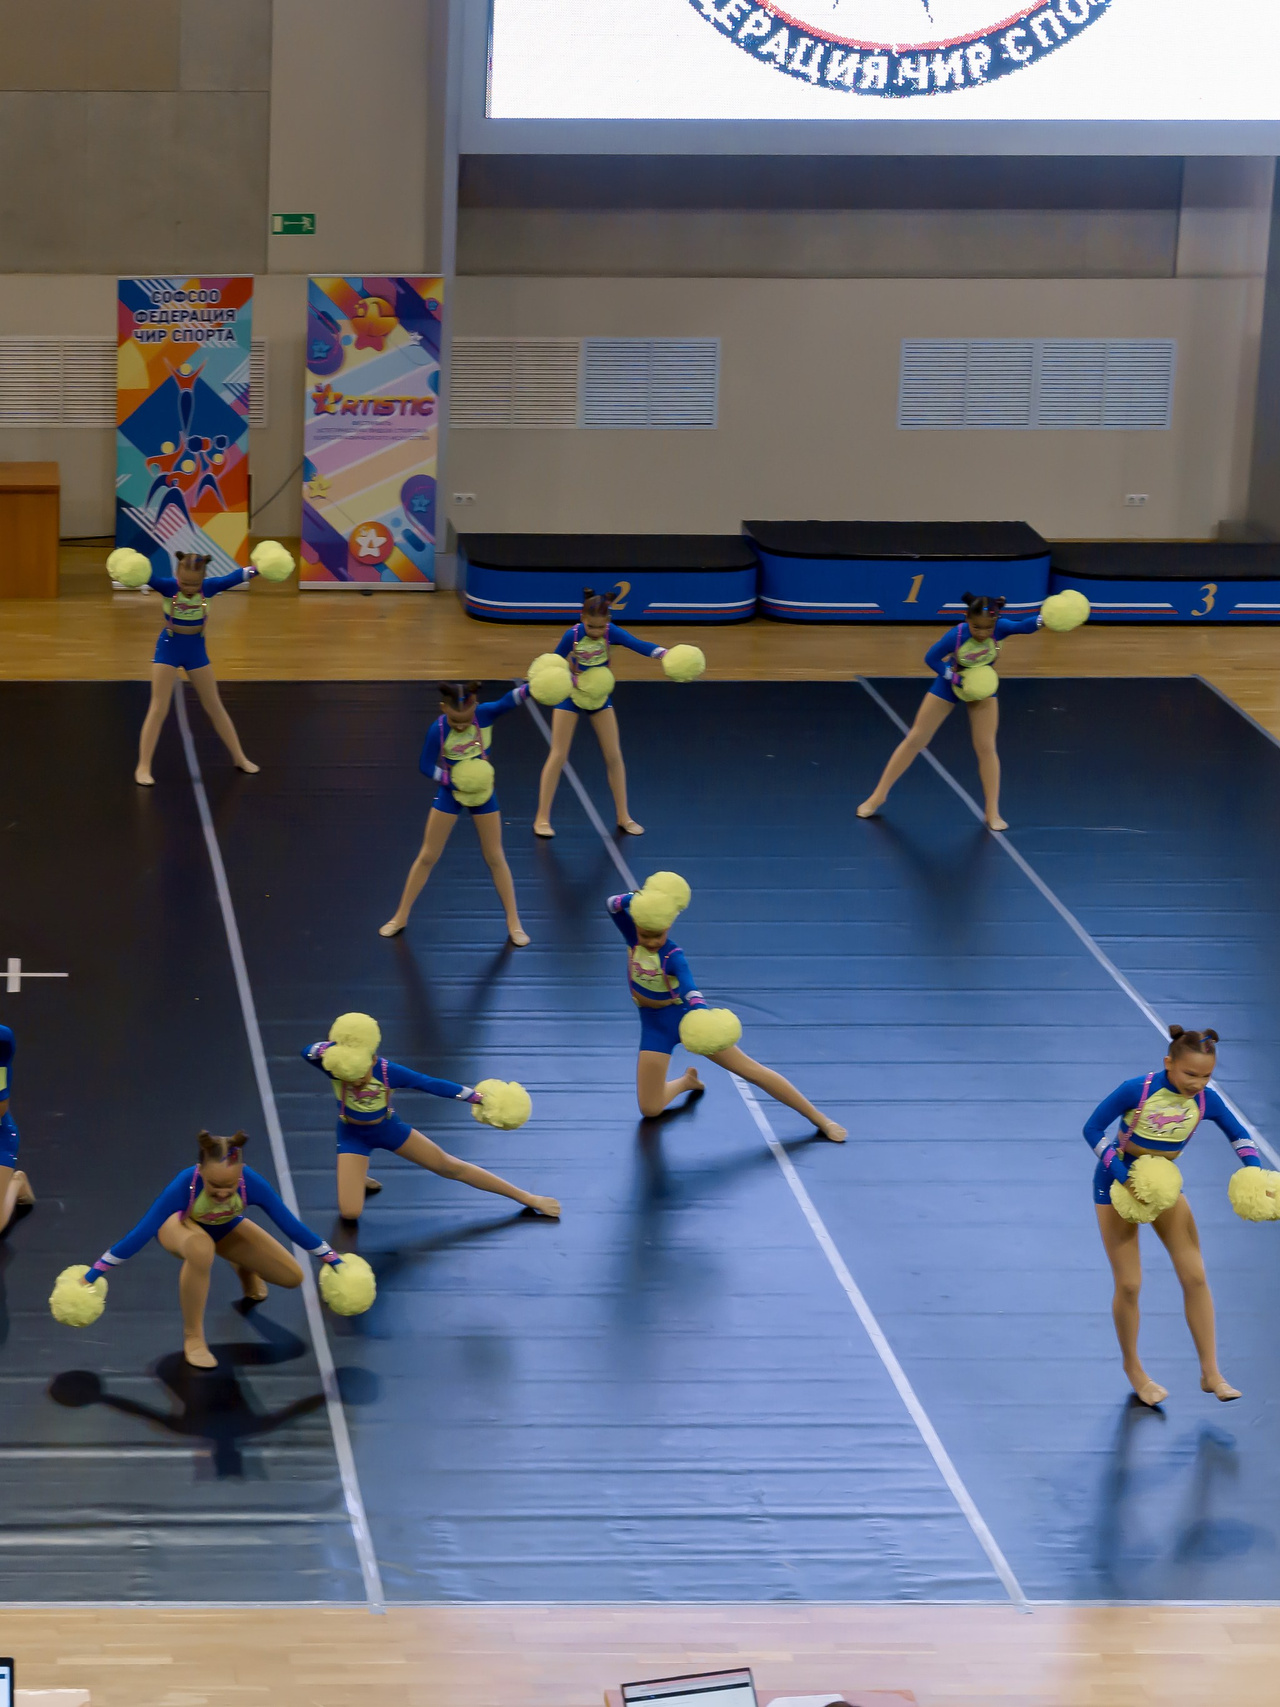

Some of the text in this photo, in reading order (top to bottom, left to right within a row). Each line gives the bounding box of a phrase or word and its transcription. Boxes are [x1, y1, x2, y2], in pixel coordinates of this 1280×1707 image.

[697, 0, 1108, 90] ЕРАЦИЯ ЧИР СПО
[151, 289, 220, 304] СОФСОО
[134, 308, 237, 325] ФЕДЕРАЦИЯ
[133, 328, 237, 343] ЧИР СПОРТА
[609, 580, 631, 611] 2
[902, 574, 924, 603] 1
[1190, 583, 1218, 617] 3
